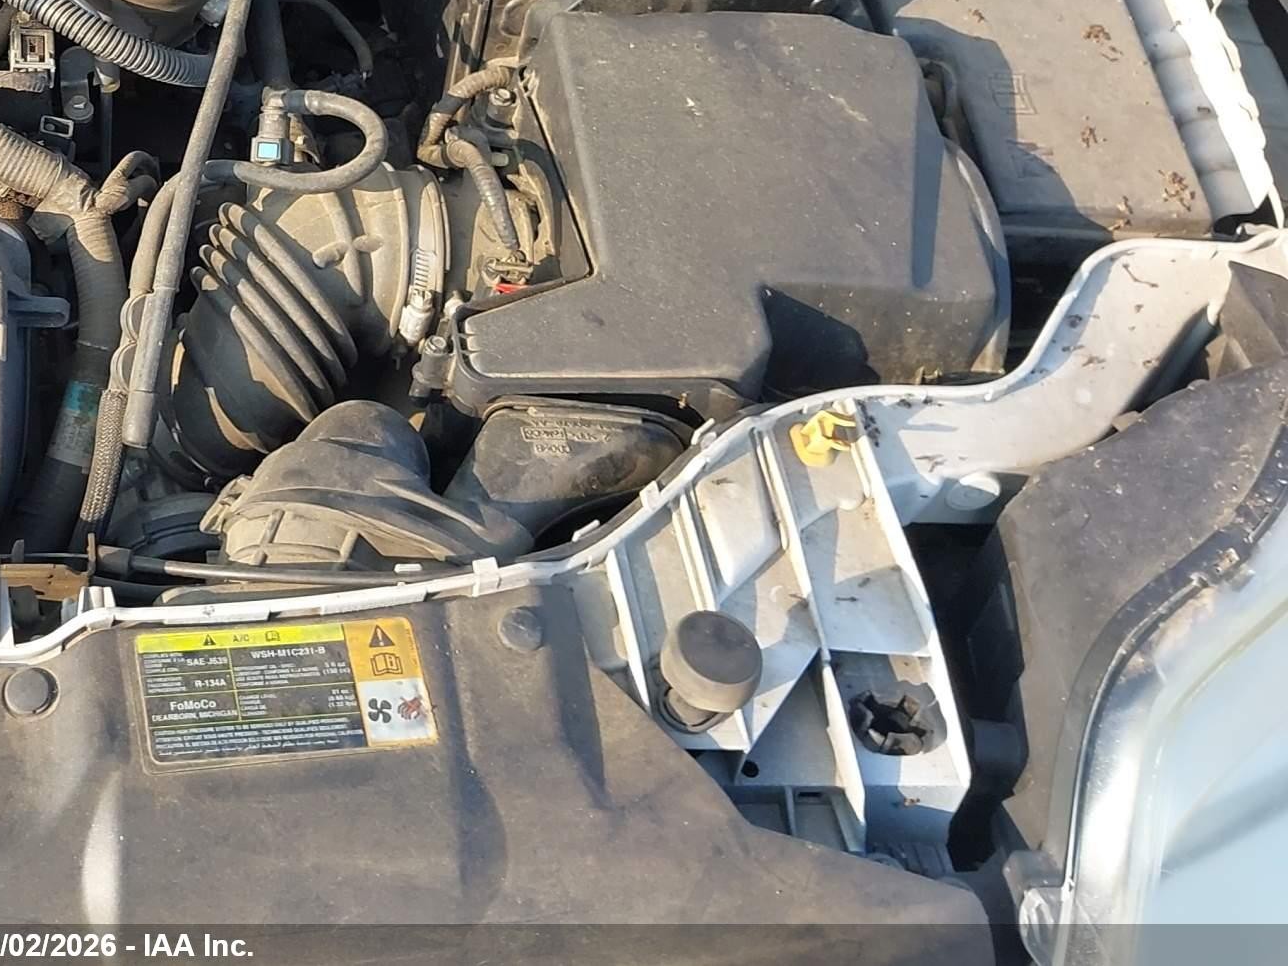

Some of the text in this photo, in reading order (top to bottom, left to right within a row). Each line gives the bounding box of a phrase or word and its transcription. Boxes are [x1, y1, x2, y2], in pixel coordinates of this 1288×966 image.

[232, 633, 250, 643] A/C
[194, 678, 227, 689] R-134A
[169, 699, 217, 711] FoMoCo
